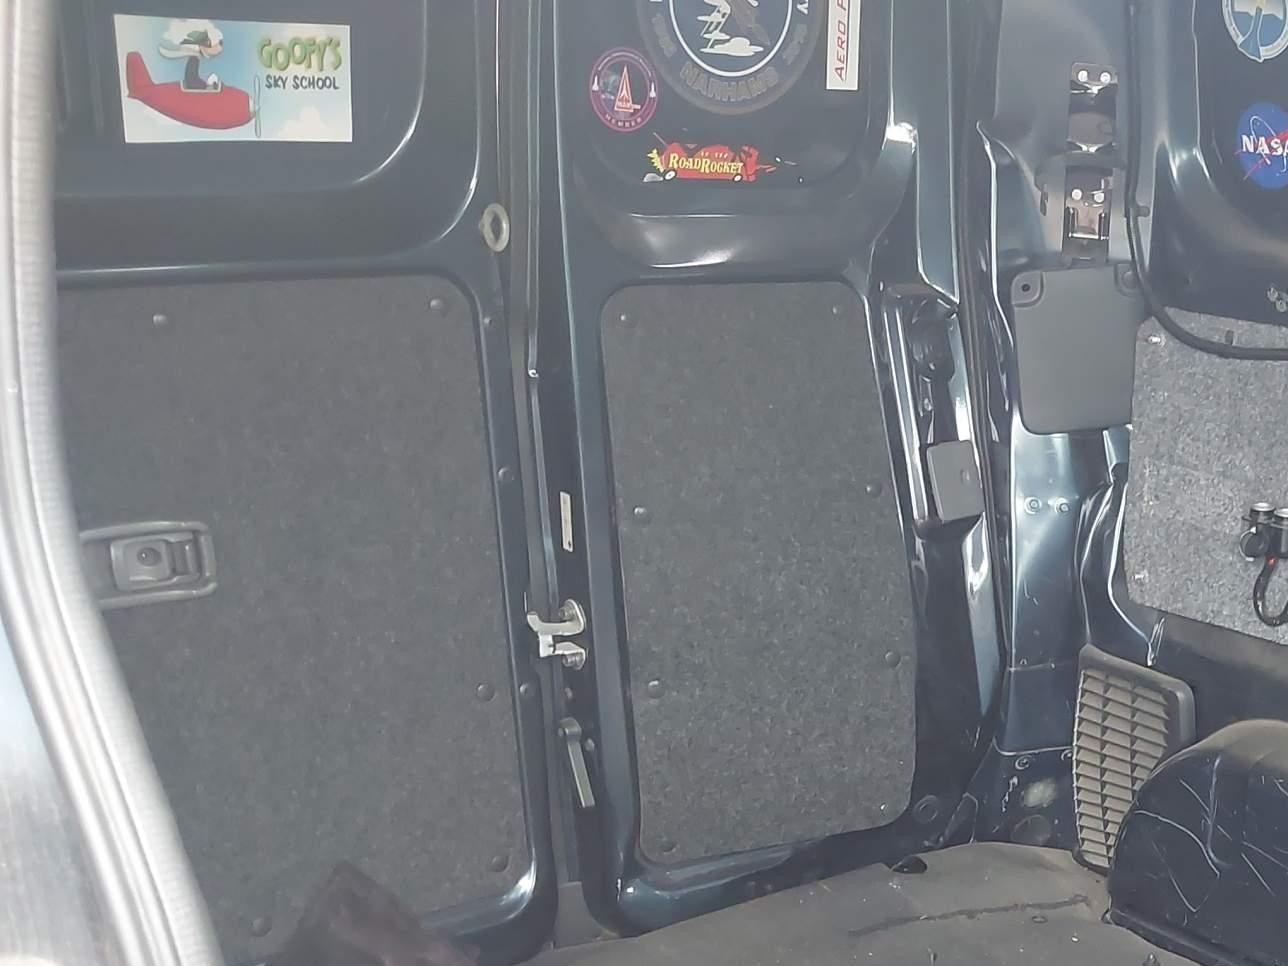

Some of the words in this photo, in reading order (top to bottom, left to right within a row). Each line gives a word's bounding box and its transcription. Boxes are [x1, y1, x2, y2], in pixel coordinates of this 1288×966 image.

[257, 37, 342, 71] GOOFY'S
[833, 19, 847, 81] AERO
[265, 73, 288, 89] SKY
[292, 74, 339, 90] SCHOOL
